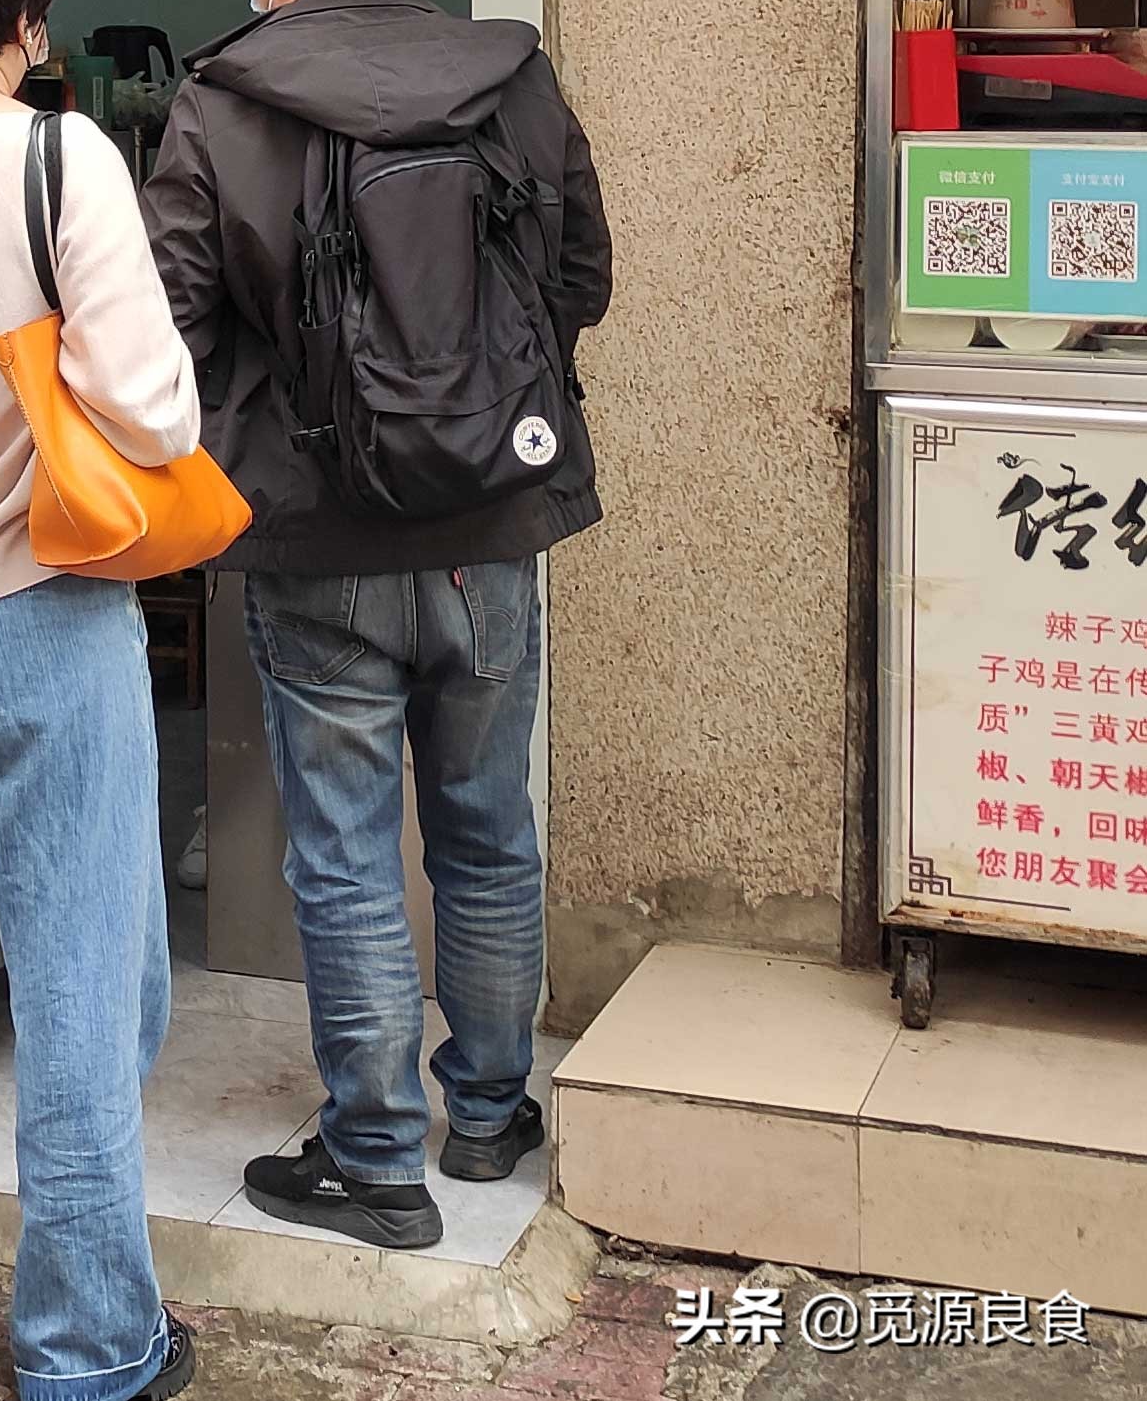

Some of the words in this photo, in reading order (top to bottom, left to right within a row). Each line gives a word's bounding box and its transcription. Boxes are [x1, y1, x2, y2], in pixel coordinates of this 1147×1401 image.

[939, 170, 996, 185] 微信支付
[1061, 173, 1125, 186] 支付宝支付
[1045, 611, 1147, 648] 辣子鸡
[978, 655, 1147, 697] 子鸡是在传
[977, 848, 1147, 894] 您朋友聚会
